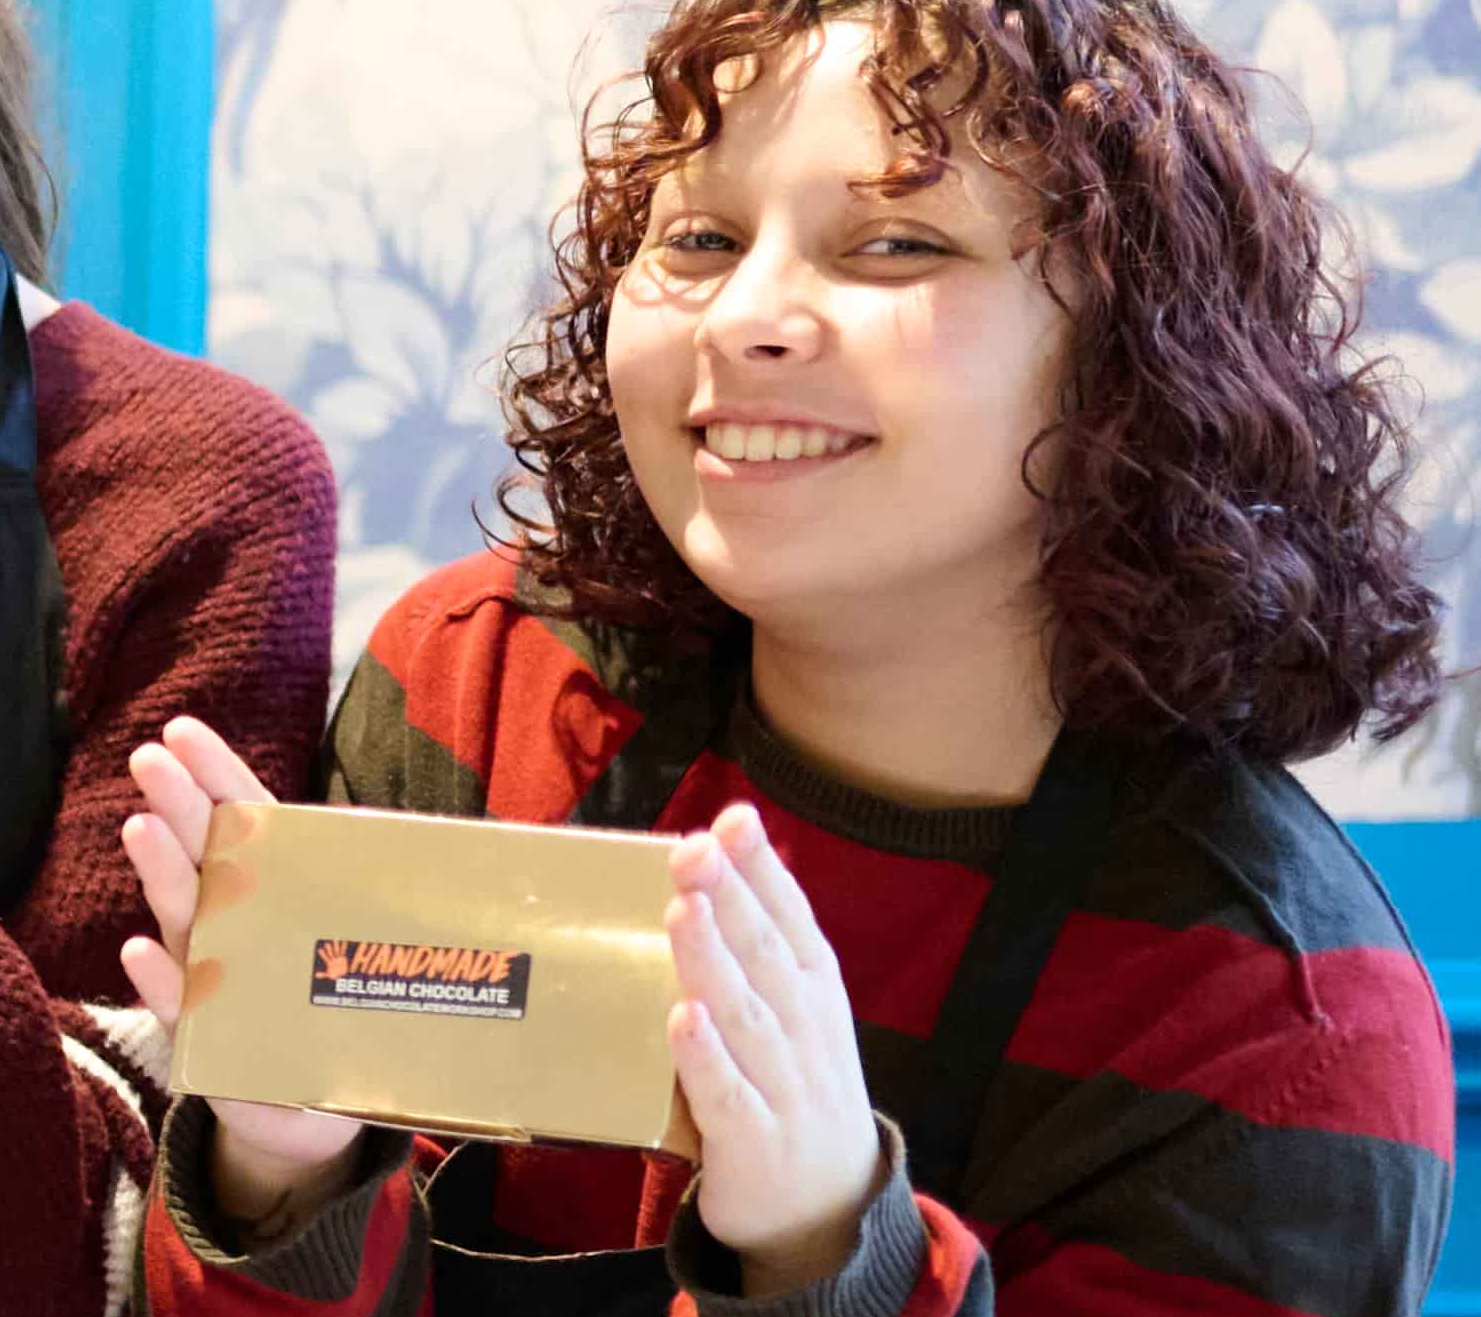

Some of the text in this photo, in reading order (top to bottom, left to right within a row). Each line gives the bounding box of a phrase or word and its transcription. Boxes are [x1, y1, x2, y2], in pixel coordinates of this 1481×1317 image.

[350, 941, 518, 984] HANDMADE
[335, 978, 510, 1005] BELGIAN CHOCOLATE
